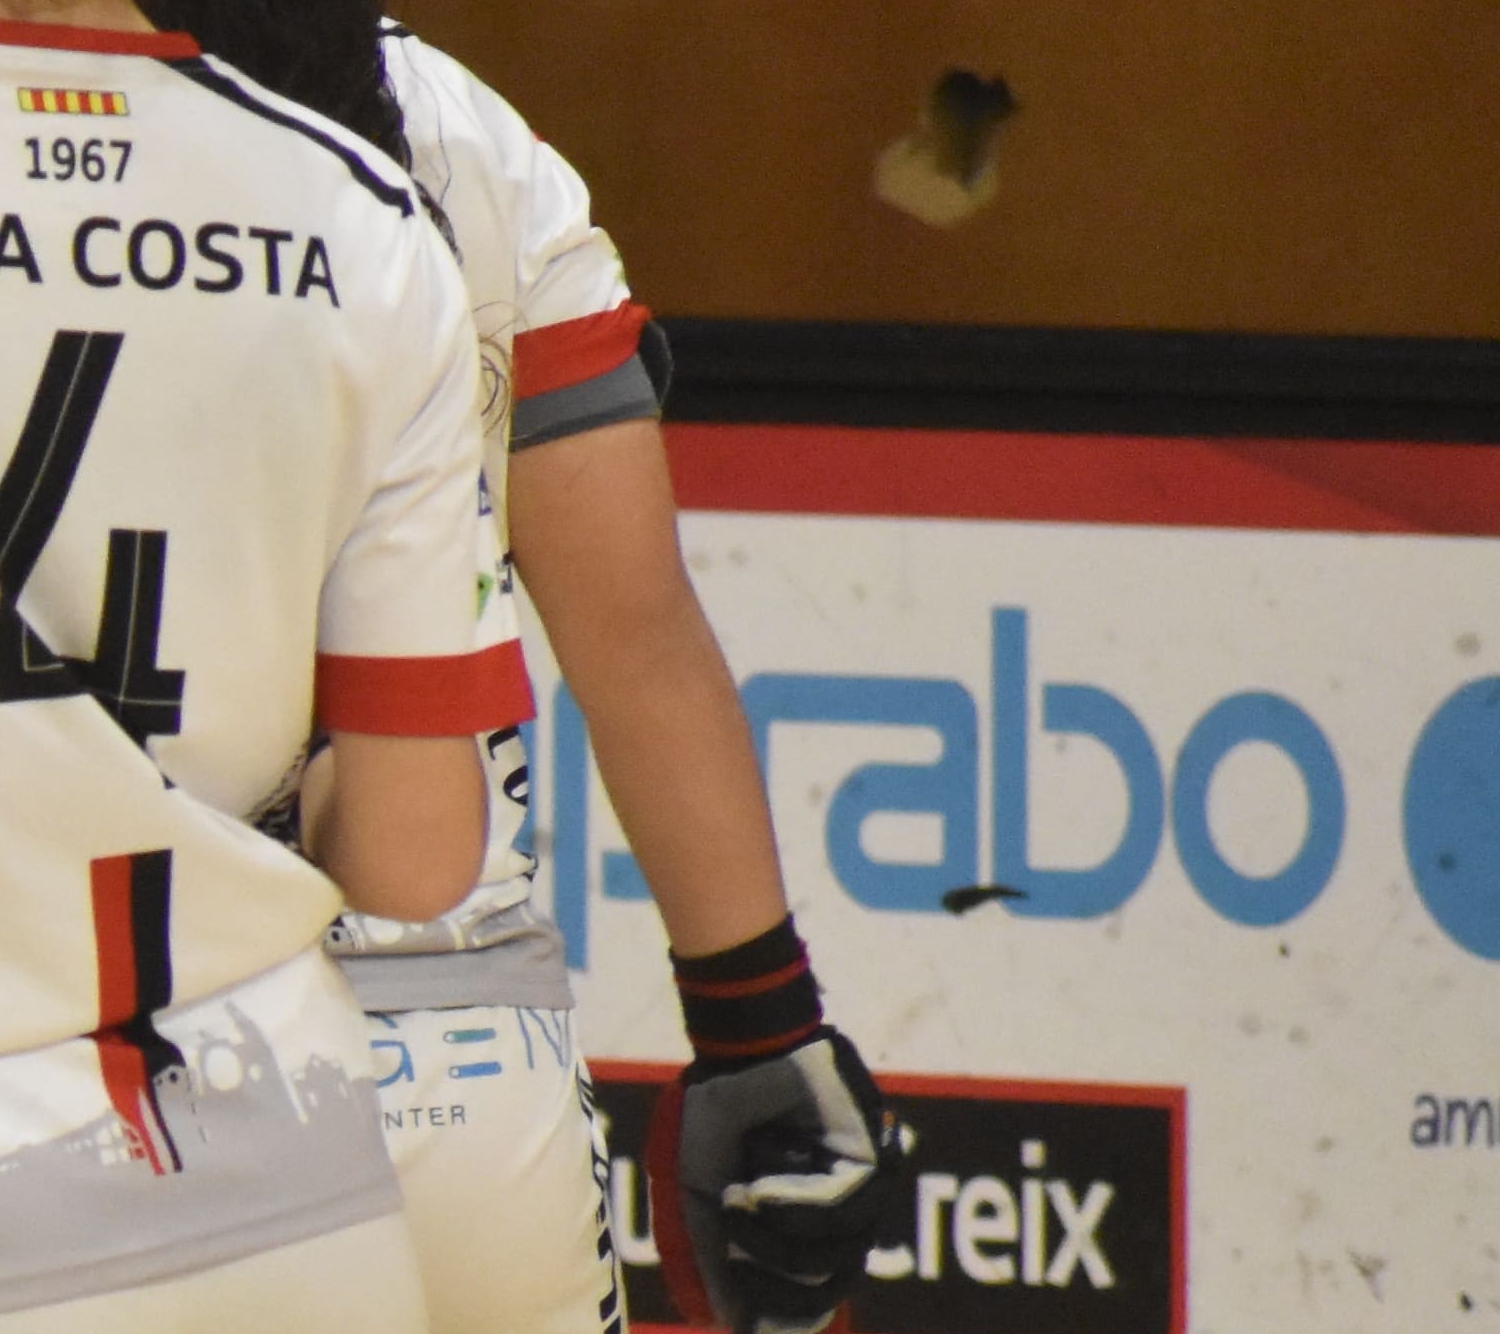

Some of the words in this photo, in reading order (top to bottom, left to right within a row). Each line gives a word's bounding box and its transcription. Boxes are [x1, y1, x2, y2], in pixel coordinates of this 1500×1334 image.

[23, 136, 133, 183] 1967
[71, 216, 341, 309] COSTA
[384, 1105, 468, 1130] NTER
[1410, 1091, 1500, 1149] am
